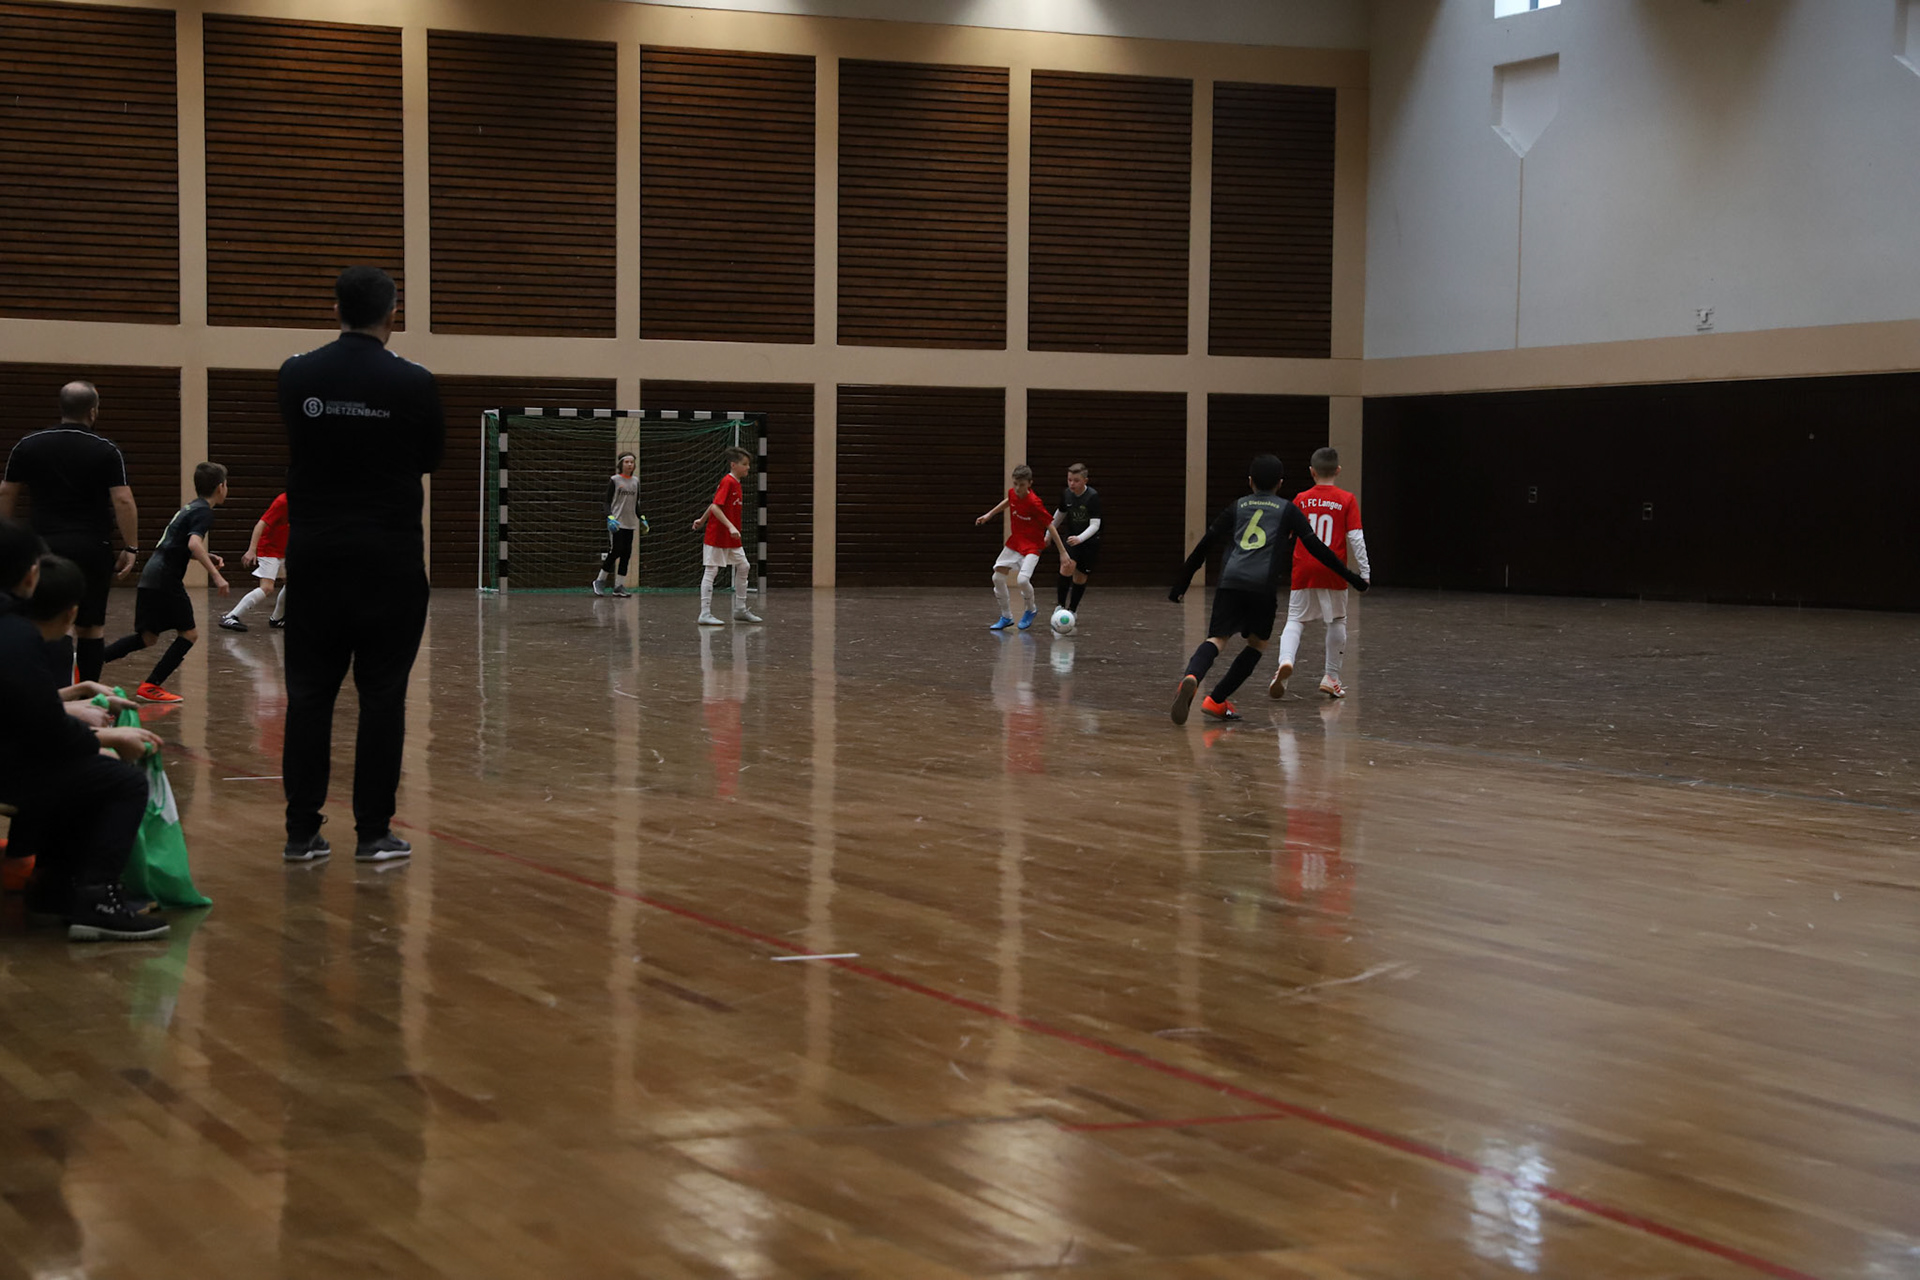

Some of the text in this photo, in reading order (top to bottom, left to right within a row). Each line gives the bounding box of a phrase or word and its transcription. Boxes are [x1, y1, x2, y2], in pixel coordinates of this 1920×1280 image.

[326, 406, 390, 418] DIETZENBACH
[1308, 498, 1317, 507] FC
[1318, 499, 1343, 511] Langen
[1240, 508, 1267, 551] 6
[1308, 513, 1334, 548] 10
